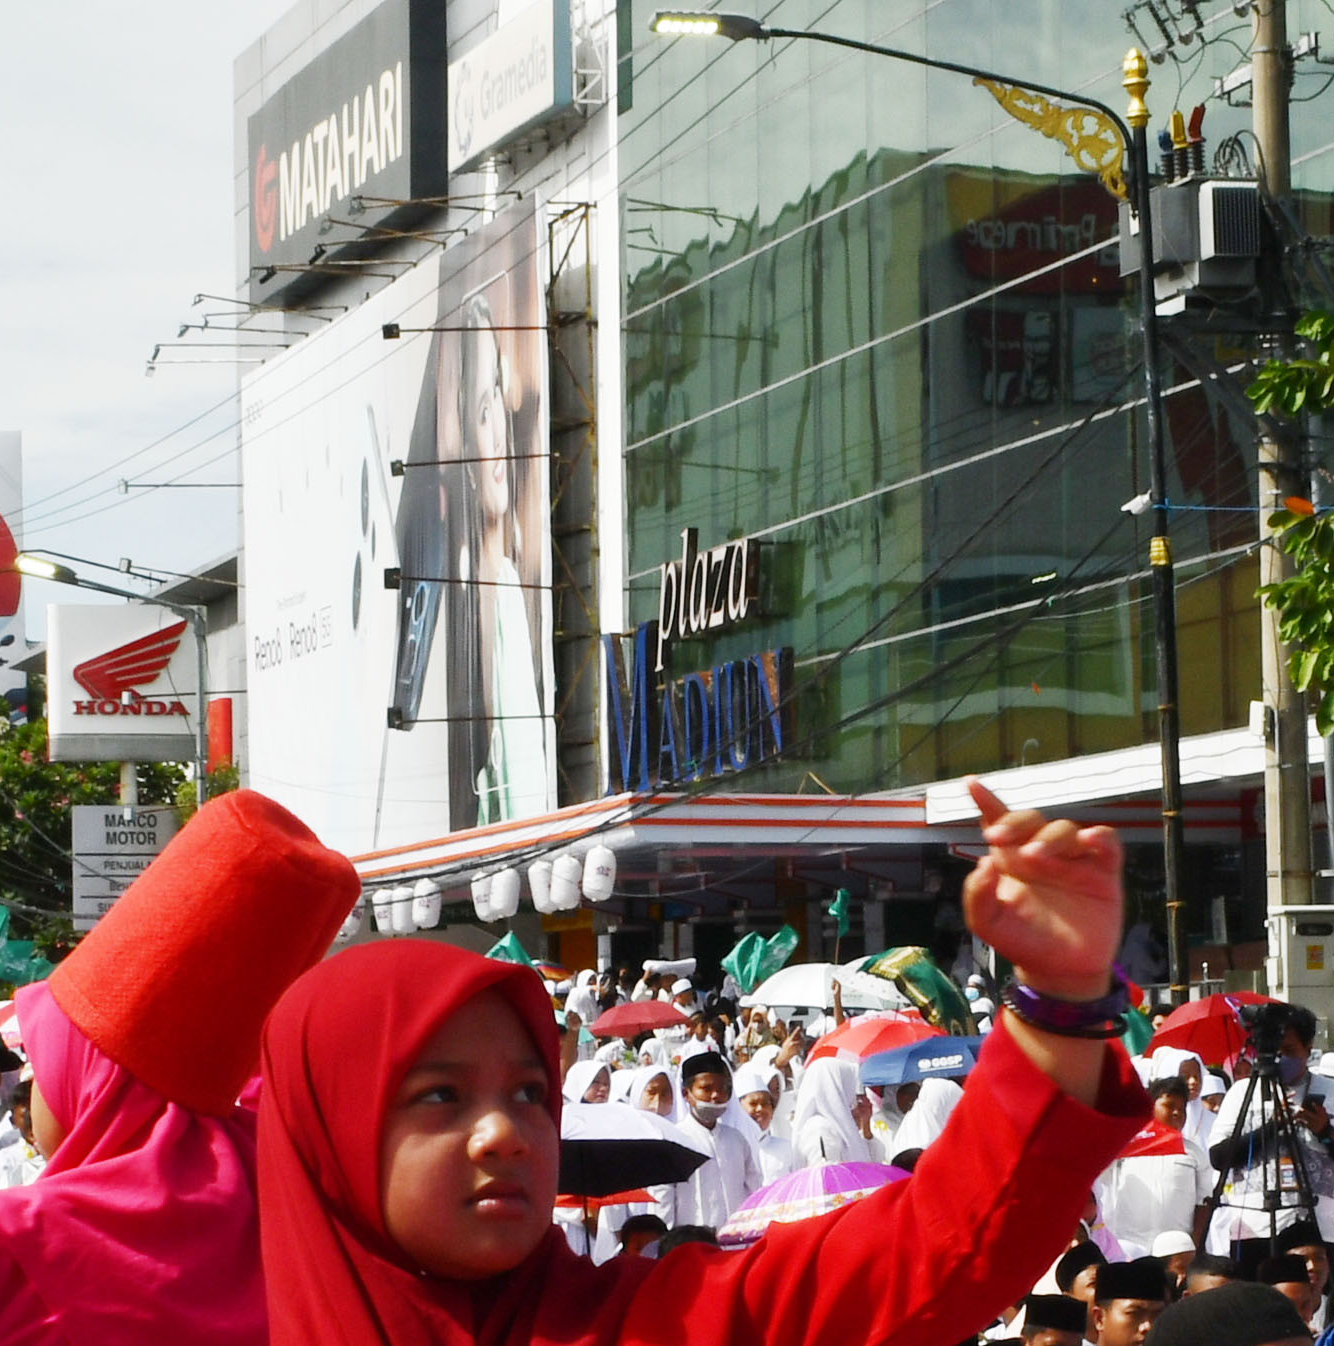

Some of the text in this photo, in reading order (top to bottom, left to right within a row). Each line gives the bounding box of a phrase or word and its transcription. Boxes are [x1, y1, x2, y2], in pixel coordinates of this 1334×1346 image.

[480, 35, 547, 120] Gramedia
[279, 61, 403, 241] MATAHARI
[655, 528, 749, 672] plaza
[73, 698, 190, 716] HONDA
[601, 620, 783, 795] MADIUN
[106, 831, 157, 845] MOTOR
